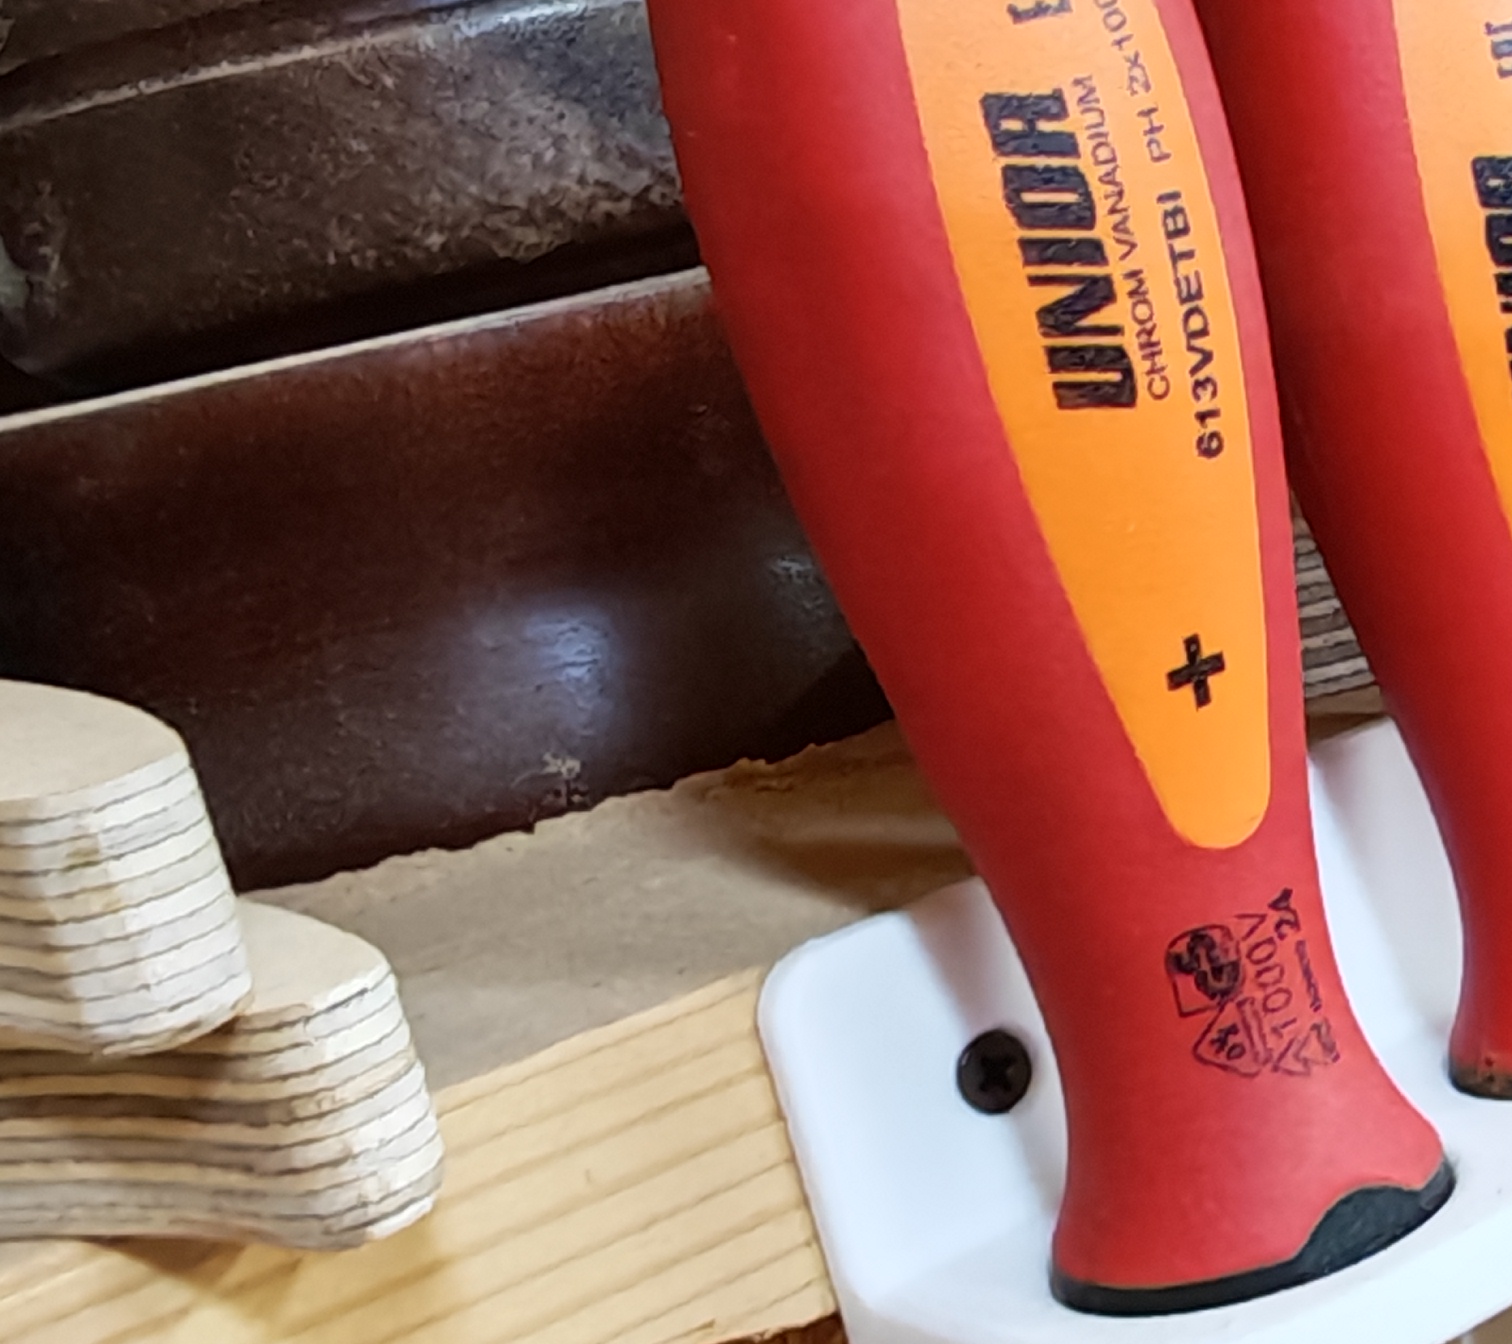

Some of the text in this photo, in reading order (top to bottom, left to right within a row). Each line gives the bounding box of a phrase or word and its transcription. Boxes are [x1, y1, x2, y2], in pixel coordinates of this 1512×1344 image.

[979, 88, 1138, 410] UNIOR
[1071, 75, 1170, 401] CHROM VANADIUM
[1137, 106, 1171, 164] PH
[1157, 190, 1225, 459] 613VDETBI
[1233, 913, 1297, 1037] 1000V
